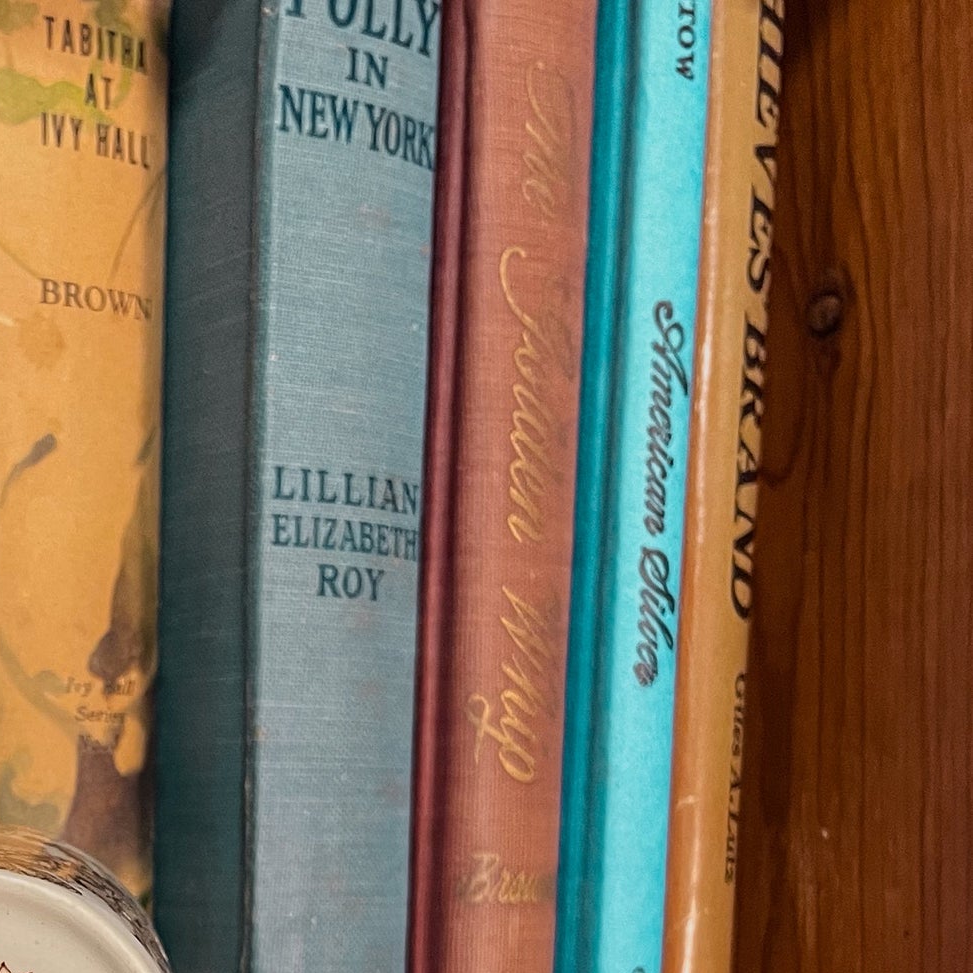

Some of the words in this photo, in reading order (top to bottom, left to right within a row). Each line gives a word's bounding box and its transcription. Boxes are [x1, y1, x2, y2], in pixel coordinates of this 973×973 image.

[43, 15, 147, 72] TABITHA
[345, 46, 389, 89] IN
[84, 73, 114, 111] AT
[40, 111, 83, 152] IVY
[95, 123, 151, 170] HALL
[278, 84, 359, 146] NEW
[364, 103, 437, 173] YORK
[39, 277, 154, 321] BROWN
[643, 299, 689, 538] American
[272, 466, 420, 516] LILLIAN
[271, 514, 419, 562] ELIZABETH
[317, 563, 385, 602] ROY
[632, 546, 676, 689] Silver
